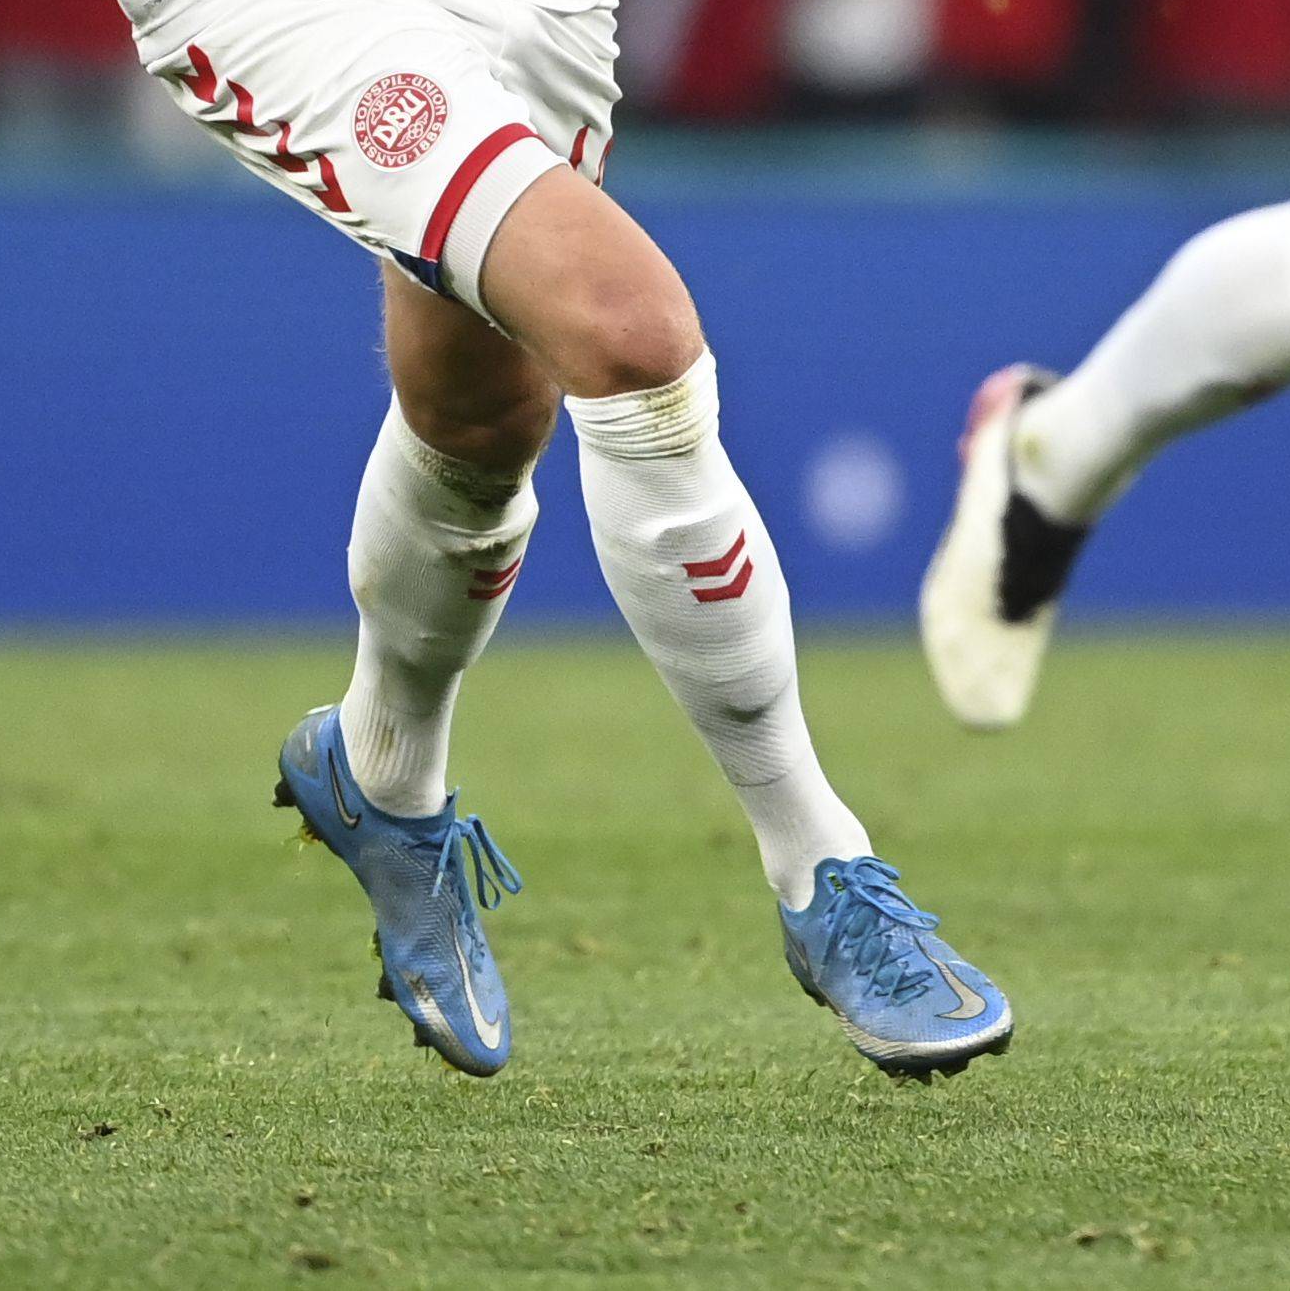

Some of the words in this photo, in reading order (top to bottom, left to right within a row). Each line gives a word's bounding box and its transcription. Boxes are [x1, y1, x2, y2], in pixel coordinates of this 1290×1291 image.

[360, 136, 408, 166] DANSK
[412, 77, 446, 115] UNION
[372, 90, 427, 149] DBU
[413, 122, 442, 158] 1889
